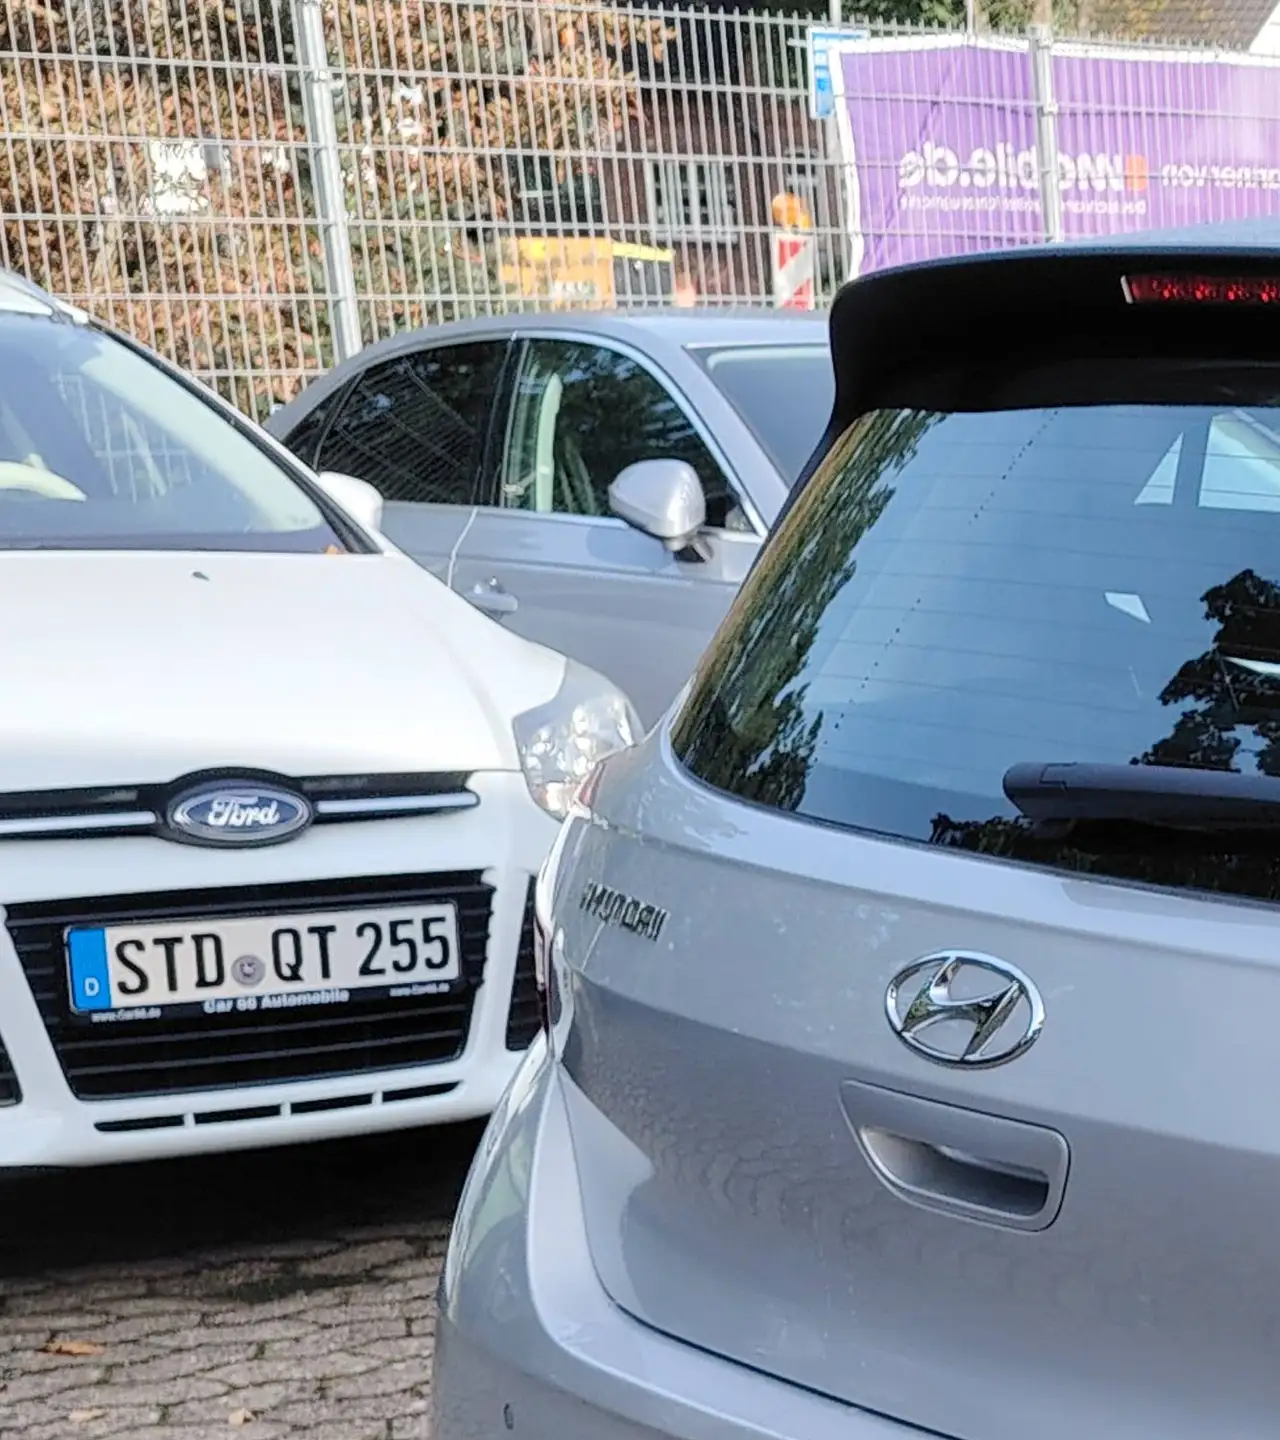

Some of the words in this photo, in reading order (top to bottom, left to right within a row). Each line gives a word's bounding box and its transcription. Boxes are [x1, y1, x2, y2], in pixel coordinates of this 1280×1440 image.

[207, 795, 280, 826] Ford
[115, 933, 226, 995] STD
[271, 925, 337, 982] QT
[356, 916, 450, 977] 255
[84, 976, 100, 996] D
[261, 988, 350, 1010] Automobile
